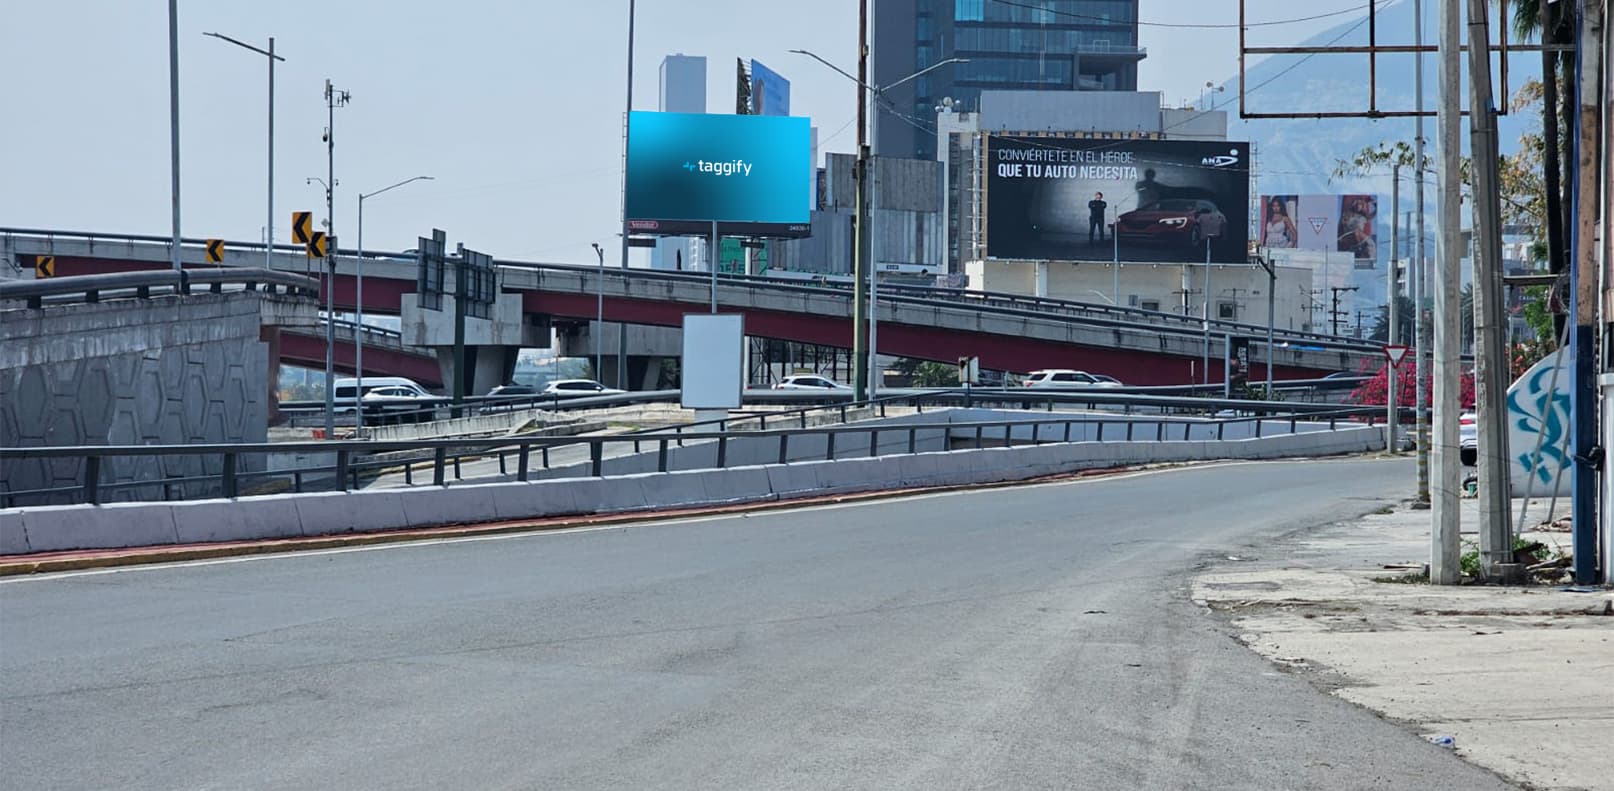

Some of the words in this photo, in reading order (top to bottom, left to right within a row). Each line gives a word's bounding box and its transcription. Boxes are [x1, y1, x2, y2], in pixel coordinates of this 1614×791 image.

[998, 149, 1067, 162] CONVIÉRTETE
[1070, 150, 1083, 163] EN
[1085, 151, 1098, 163] EL
[698, 160, 752, 176] taggify
[998, 163, 1022, 178] QUE
[1025, 164, 1041, 178] TU
[1044, 165, 1077, 179] AUTO
[1079, 165, 1138, 180] NECESITA
